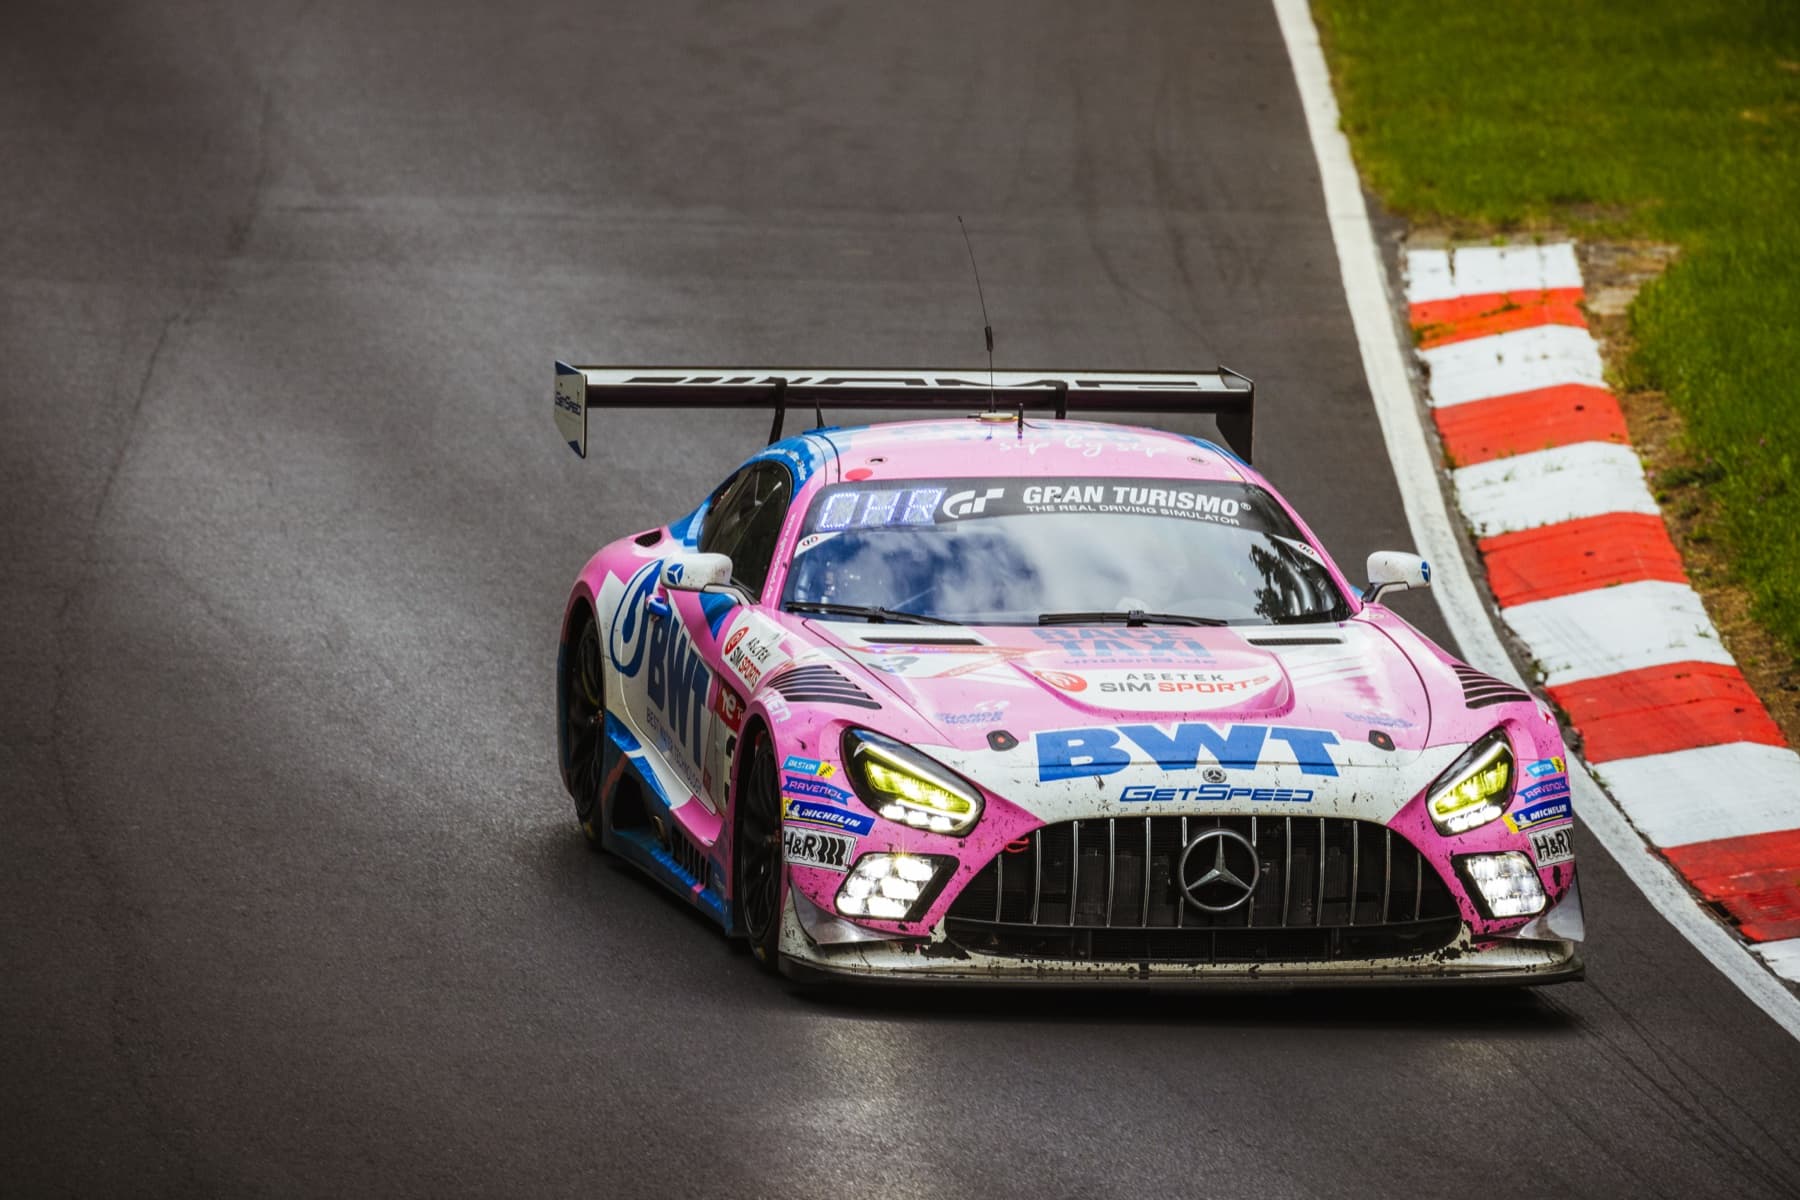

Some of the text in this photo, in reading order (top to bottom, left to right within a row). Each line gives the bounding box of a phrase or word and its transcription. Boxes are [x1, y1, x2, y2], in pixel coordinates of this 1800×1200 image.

[1022, 485, 1105, 504] GRAN
[1026, 504, 1240, 526] THE REAL DRIVING SIMULATOR
[1039, 640, 1212, 657] TAXI
[1100, 675, 1271, 693] SIM SPORTS
[1126, 672, 1225, 682] ASETEK
[648, 609, 710, 771] BWT
[1035, 722, 1340, 782] BWT
[789, 780, 844, 800] RAVENOL
[801, 808, 862, 828] MICHELIN
[1529, 803, 1568, 822] MICHELIN
[784, 830, 818, 858] H&R
[1533, 829, 1566, 861] H&R
